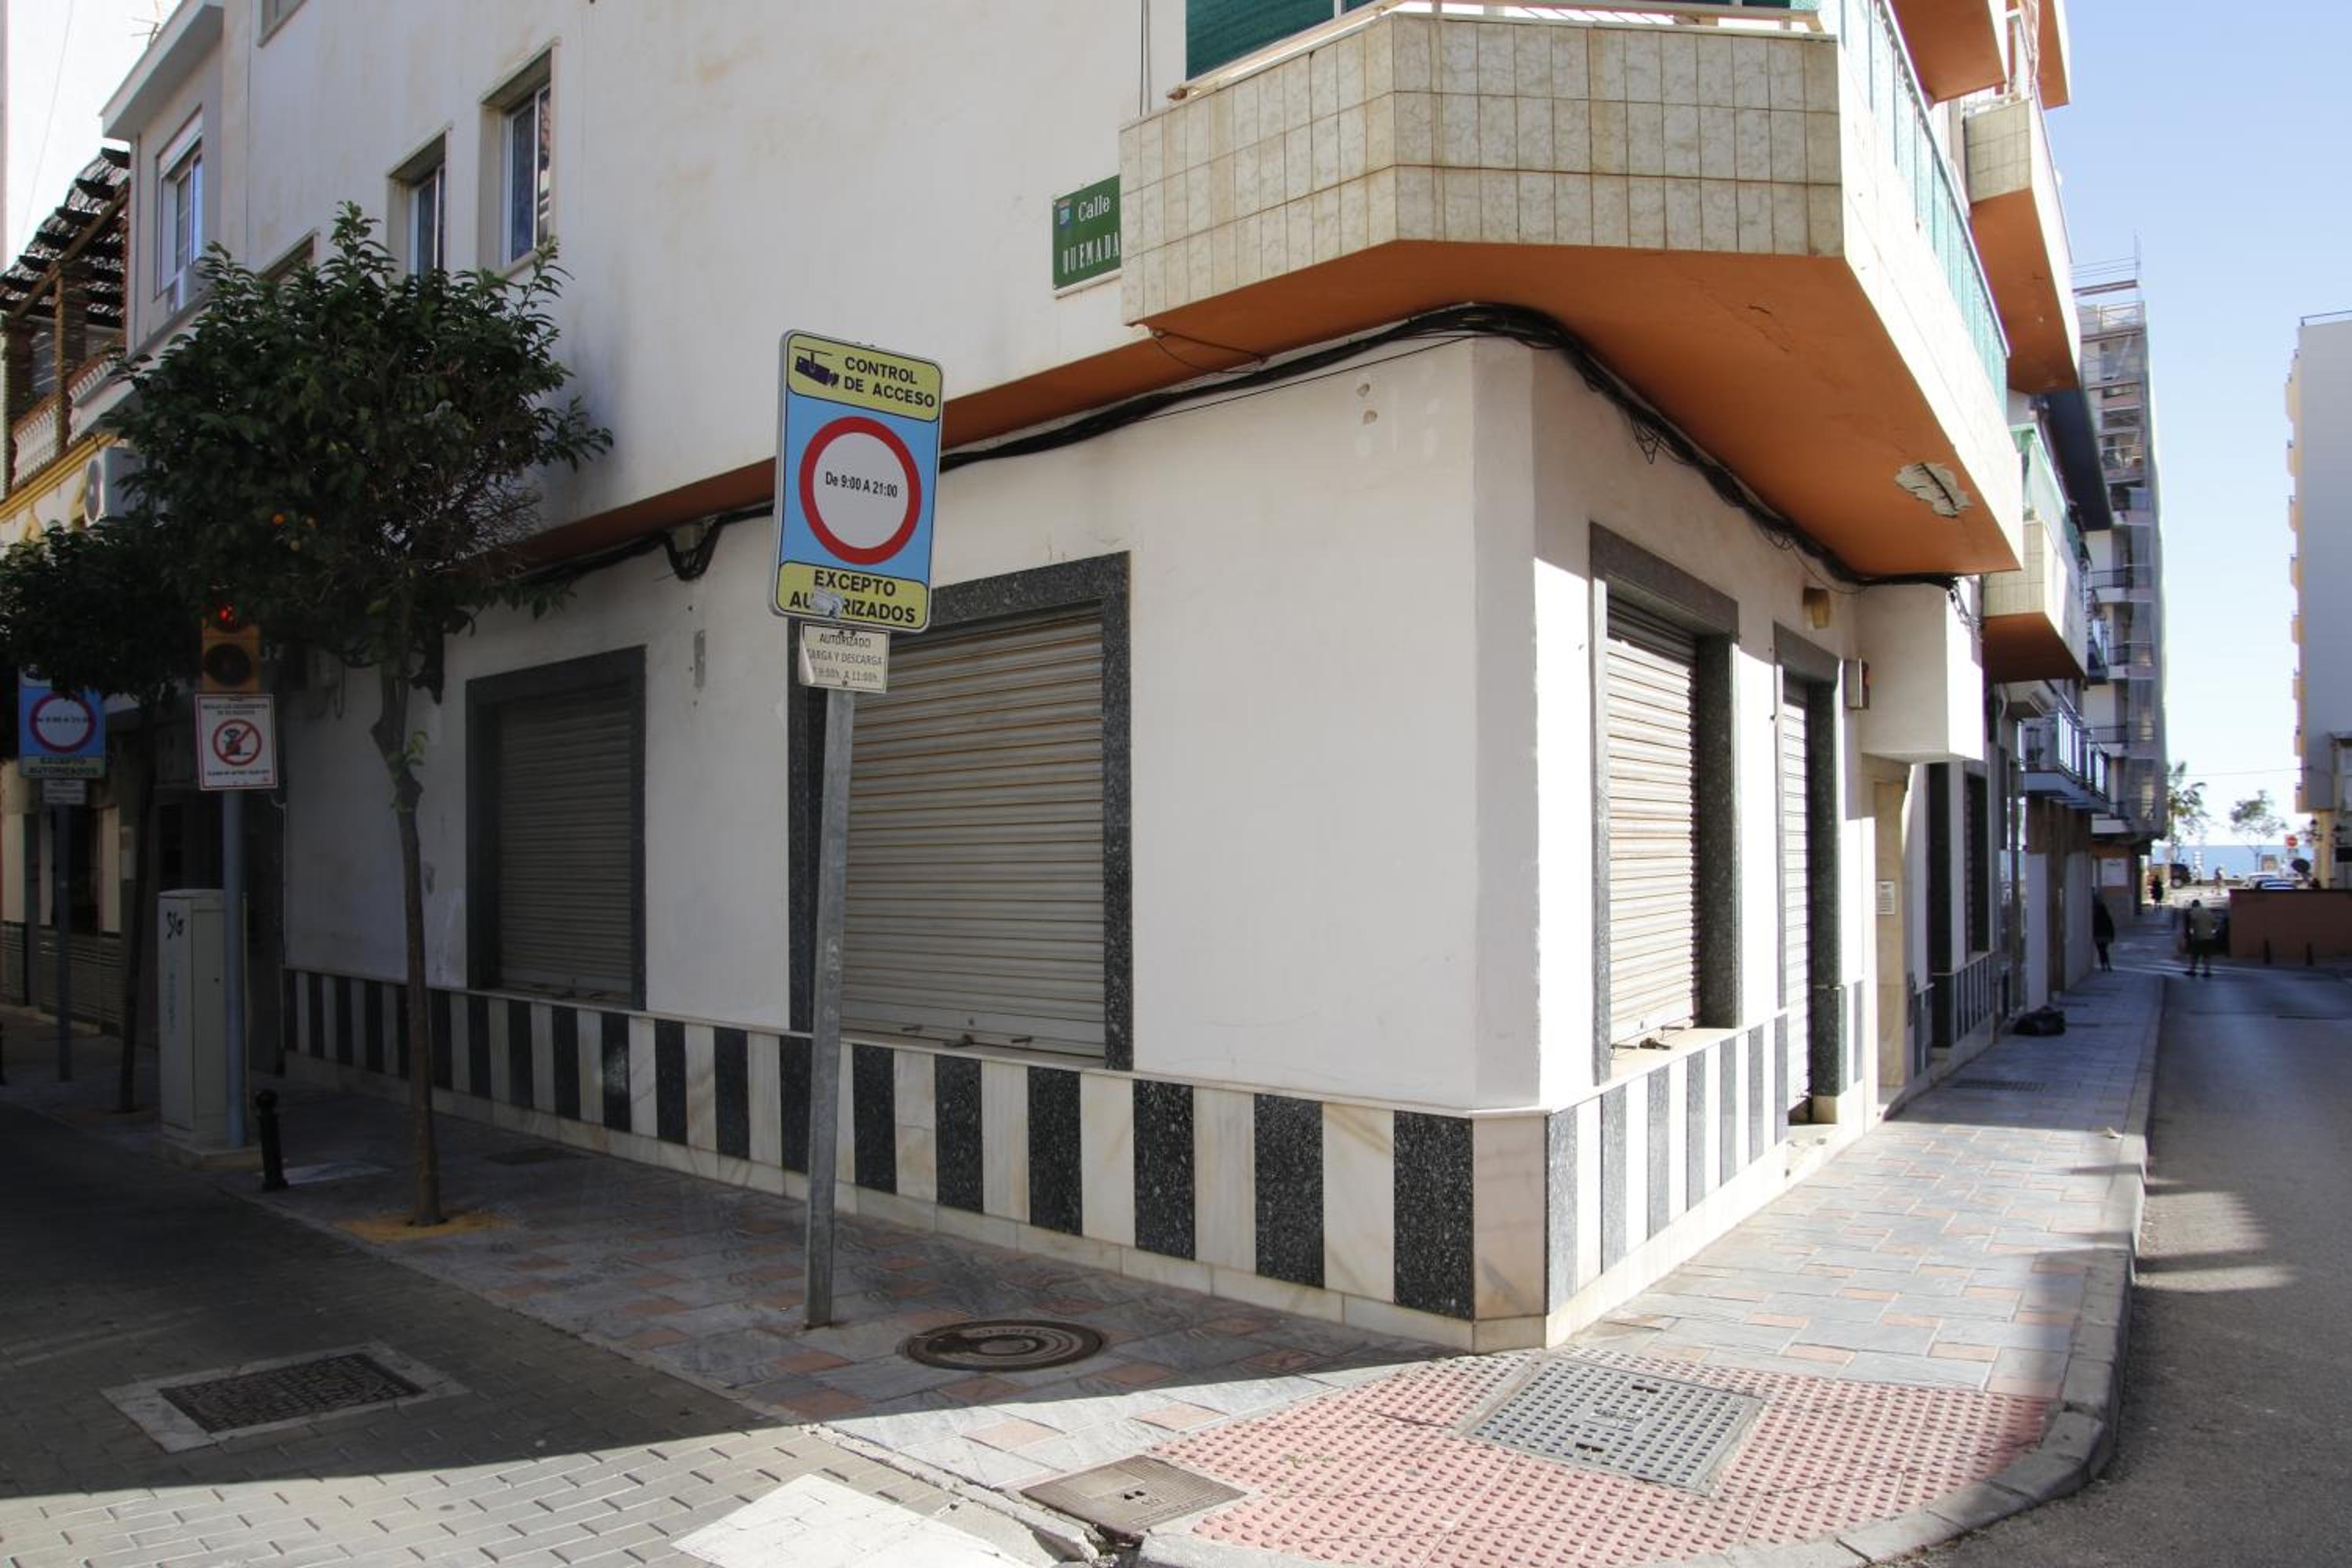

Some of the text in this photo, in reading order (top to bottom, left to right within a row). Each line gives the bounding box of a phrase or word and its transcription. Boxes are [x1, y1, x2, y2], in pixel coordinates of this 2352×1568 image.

[1078, 195, 1110, 222] Calle
[844, 357, 918, 384] CONTROL
[844, 376, 935, 408] DE ACCESO
[826, 471, 898, 498] De 9:00 A 21:00
[814, 570, 895, 597] EXCEPTO
[789, 591, 916, 623] AURIZADOS
[819, 633, 871, 648] AUTORIZADO
[841, 652, 883, 666] DESCARGA
